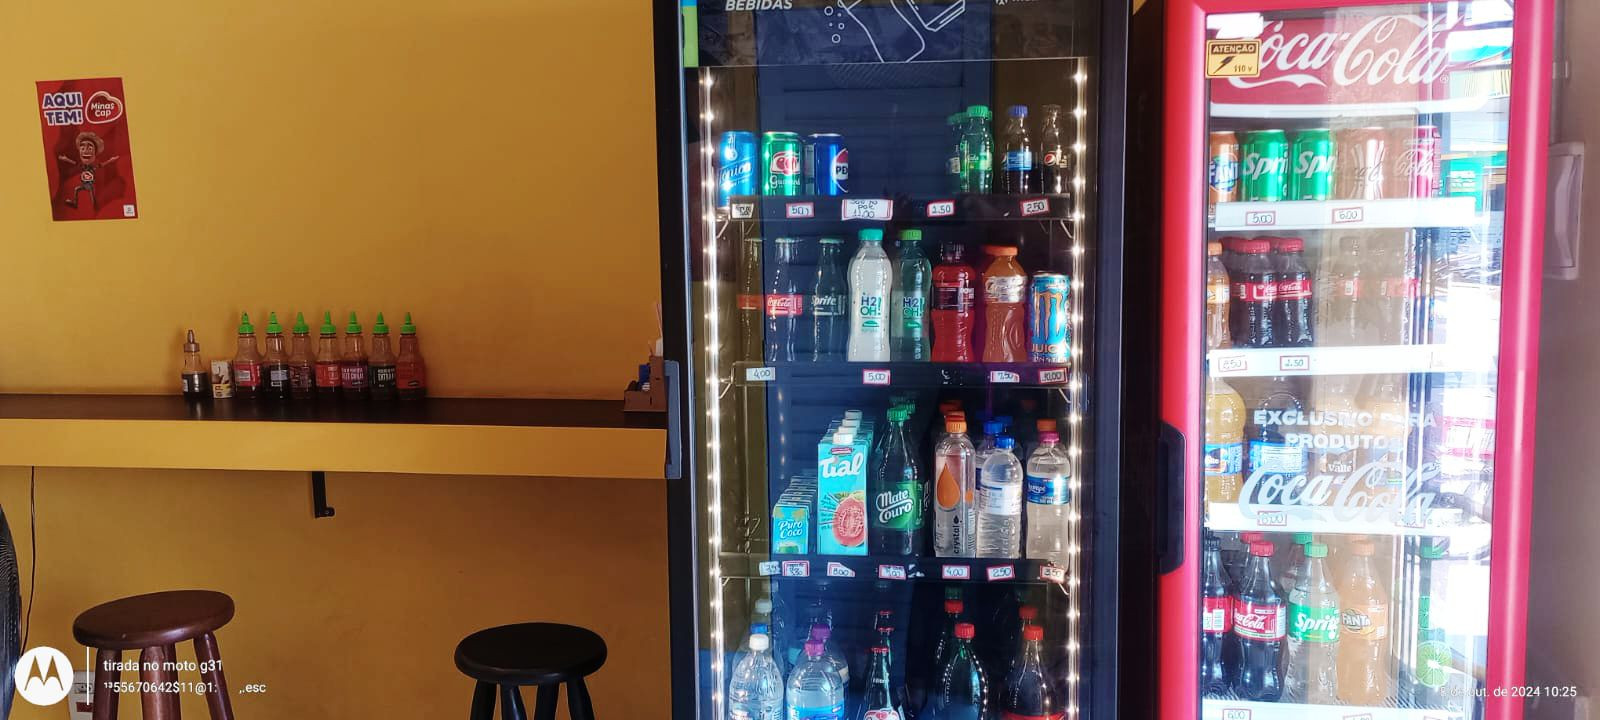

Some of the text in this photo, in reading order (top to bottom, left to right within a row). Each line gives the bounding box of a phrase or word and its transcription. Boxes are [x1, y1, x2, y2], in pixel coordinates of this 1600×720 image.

[725, 0, 793, 11] BEBIDAS
[43, 92, 83, 108] AQUI
[45, 109, 83, 125] TEM!
[95, 109, 111, 118] Cap
[1253, 410, 1373, 427] EXCLUSIVO
[819, 453, 864, 478] Tial
[876, 490, 908, 511] Mate
[879, 503, 912, 523] Couro
[952, 525, 960, 554] crystal
